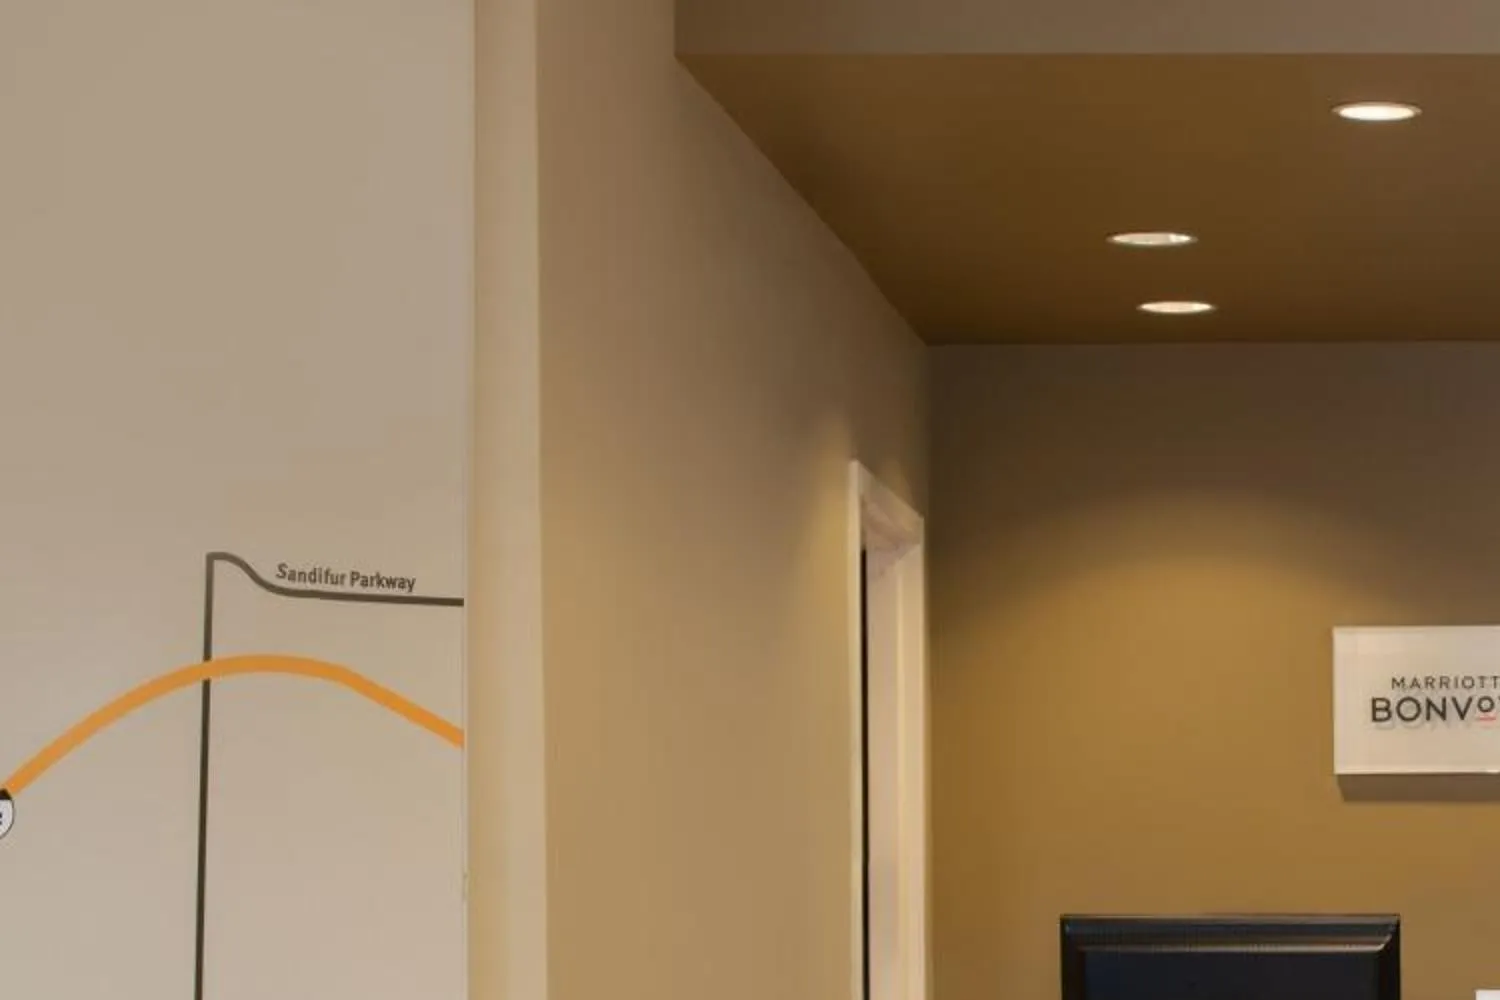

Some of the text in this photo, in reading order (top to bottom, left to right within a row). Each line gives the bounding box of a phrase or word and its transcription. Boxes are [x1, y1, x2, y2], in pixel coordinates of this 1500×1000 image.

[275, 562, 416, 593] Sandifur Parkway
[1391, 675, 1500, 689] MARRIOTT
